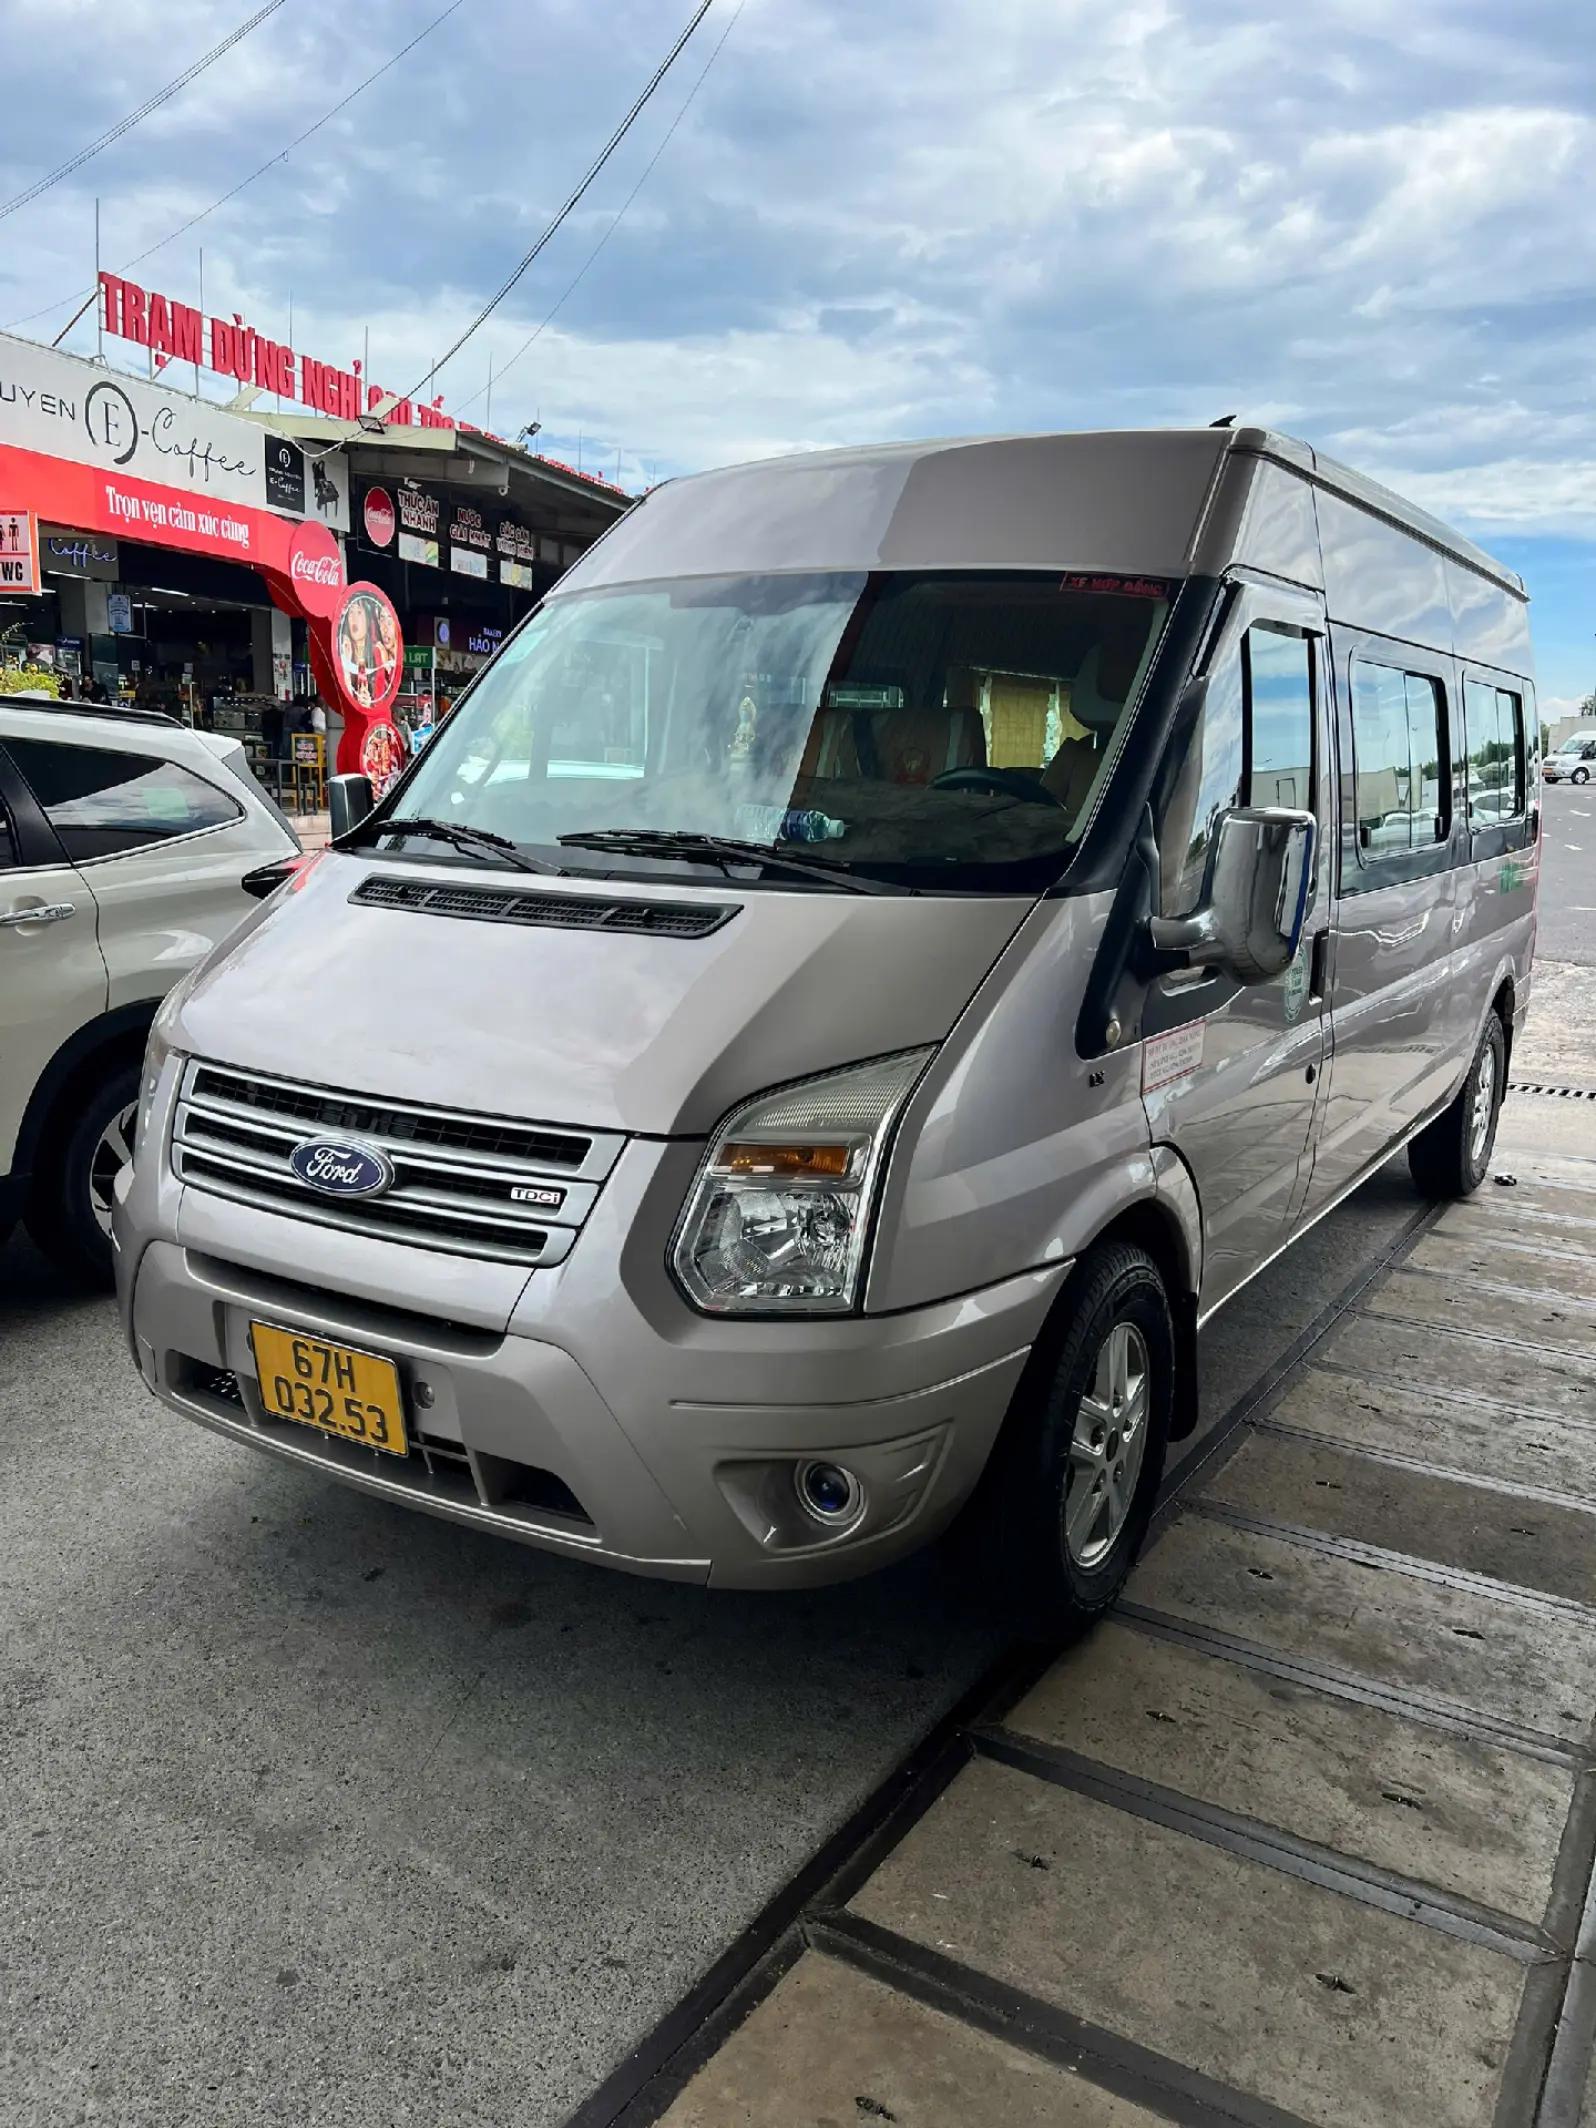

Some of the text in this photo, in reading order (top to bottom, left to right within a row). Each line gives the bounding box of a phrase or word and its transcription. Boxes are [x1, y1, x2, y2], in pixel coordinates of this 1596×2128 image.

[99, 272, 202, 369] TRẠM
[211, 313, 295, 399] DỪNG
[302, 360, 361, 421] NGHỈ
[105, 485, 249, 549] Trọn vẹn cảm xúc cùng
[401, 508, 437, 534] NHANH
[1, 562, 23, 581] WC
[291, 550, 341, 585] Coca-Cola
[306, 1147, 364, 1185] Ford
[292, 1341, 356, 1393] 67H
[274, 1377, 388, 1443] 032.53
